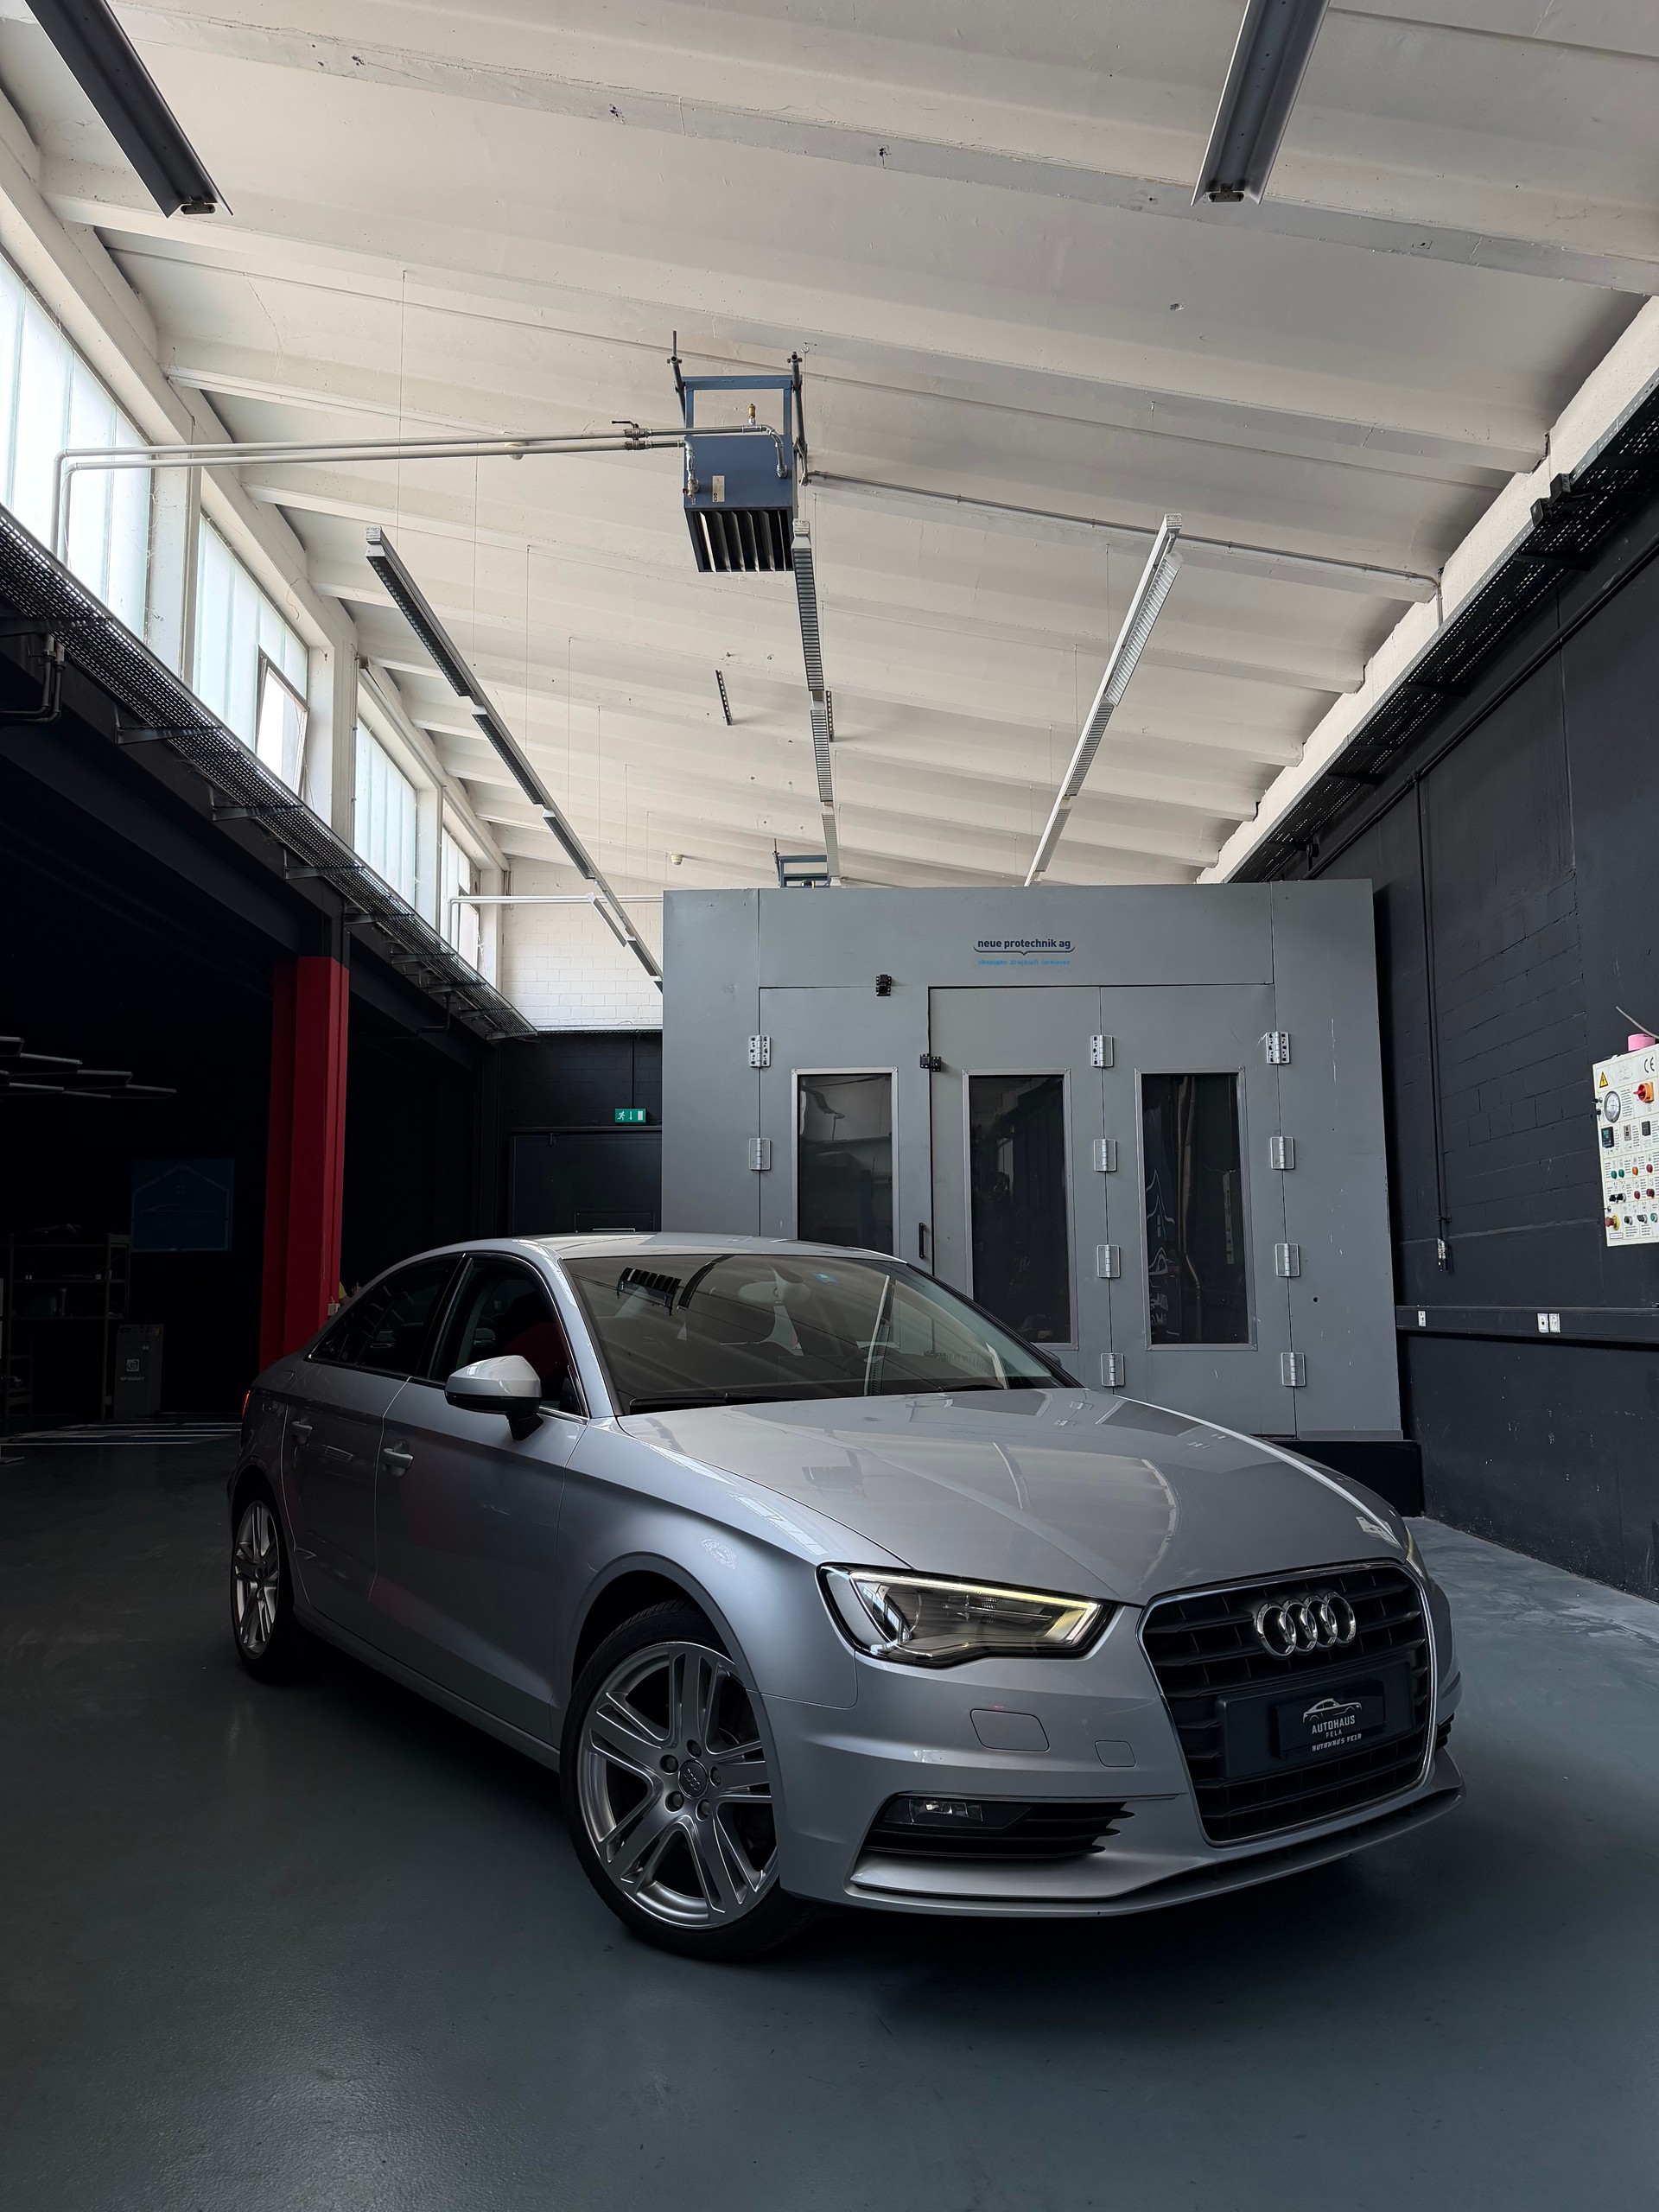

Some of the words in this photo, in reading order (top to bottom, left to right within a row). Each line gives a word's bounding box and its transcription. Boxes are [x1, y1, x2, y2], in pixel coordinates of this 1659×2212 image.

[1004, 938, 1057, 950] protechnik
[1058, 940, 1071, 950] ag
[1312, 1715, 1355, 1734] AUTOHAUS
[1325, 1729, 1342, 1738] FELA
[1312, 1738, 1345, 1751] AUTOHAUS
[1346, 1733, 1362, 1742] FELA
